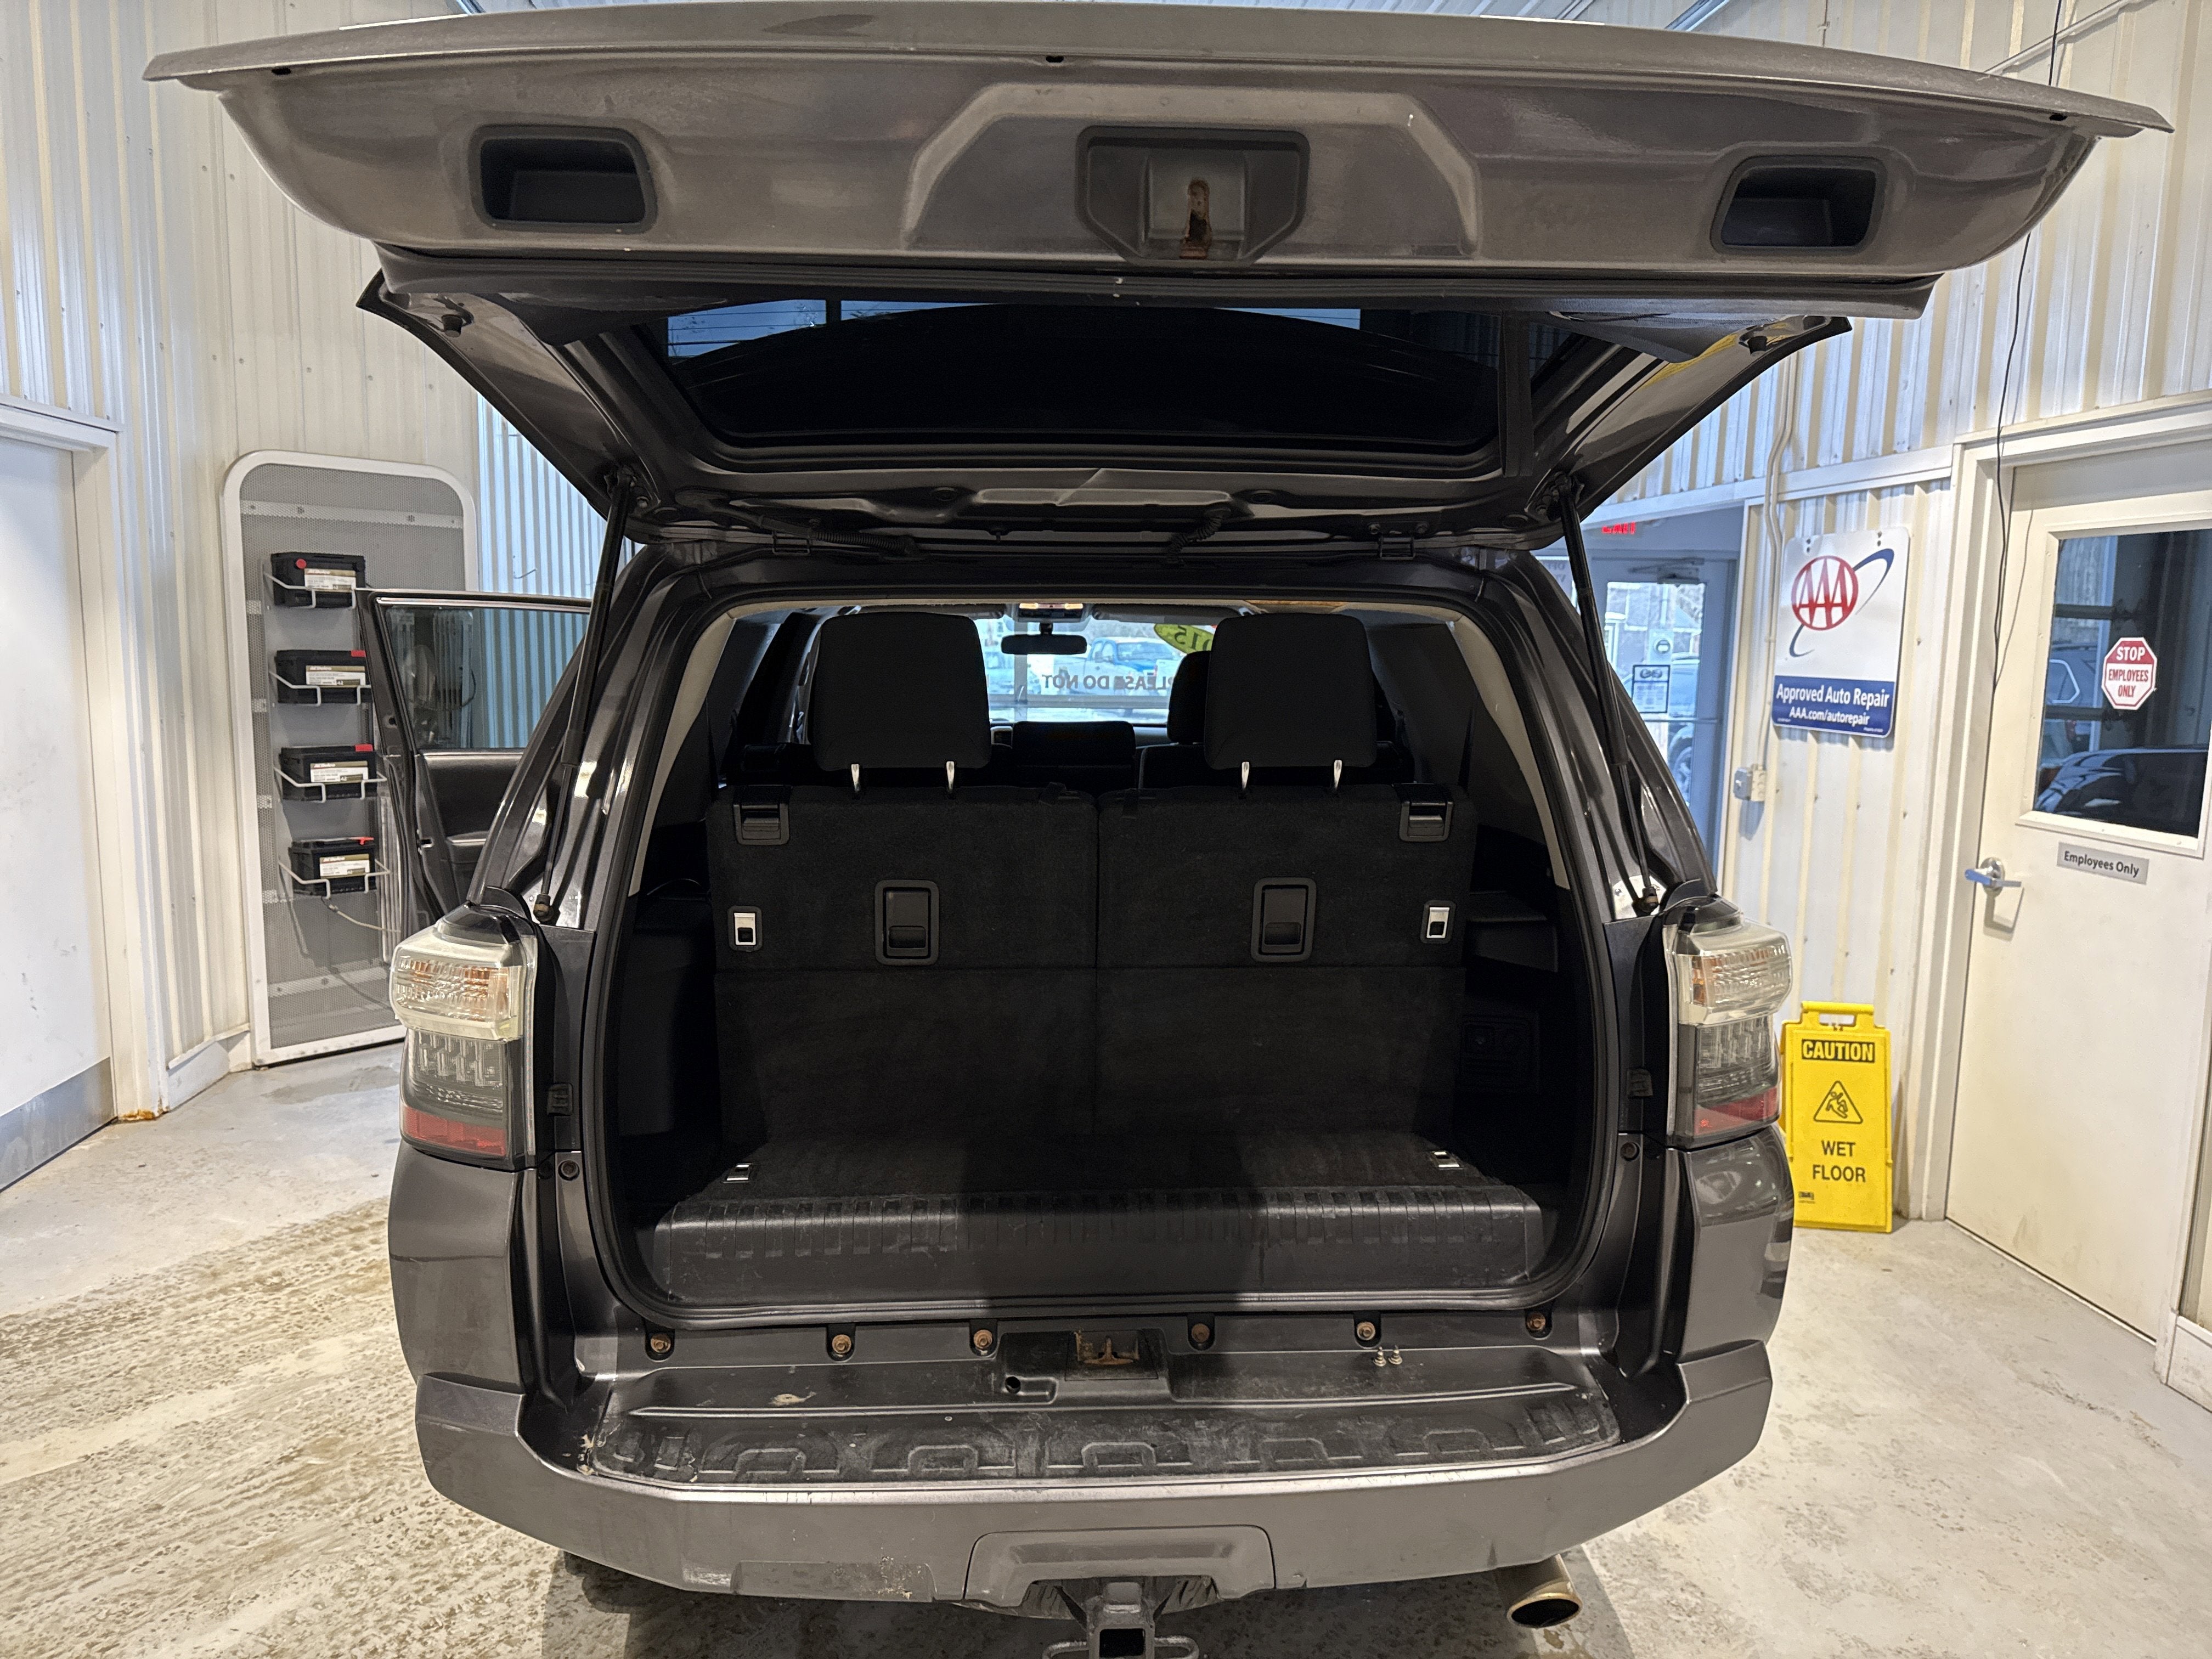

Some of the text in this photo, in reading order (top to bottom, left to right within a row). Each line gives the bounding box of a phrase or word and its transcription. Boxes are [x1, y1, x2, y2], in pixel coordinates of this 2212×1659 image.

[1793, 556, 1855, 629] AAA
[2116, 646, 2146, 661] STOP
[2108, 669, 2149, 682] EMPLOYEES
[1776, 683, 1890, 711] Approved Auto Repair
[2118, 685, 2136, 697] ONLY
[1788, 706, 1870, 727] AAA.com/autorepair
[2064, 850, 2140, 878] Employees Only
[1803, 1041, 1874, 1061] CAUTION
[1821, 1140, 1857, 1157] WET
[1812, 1164, 1866, 1183] FLOOR
